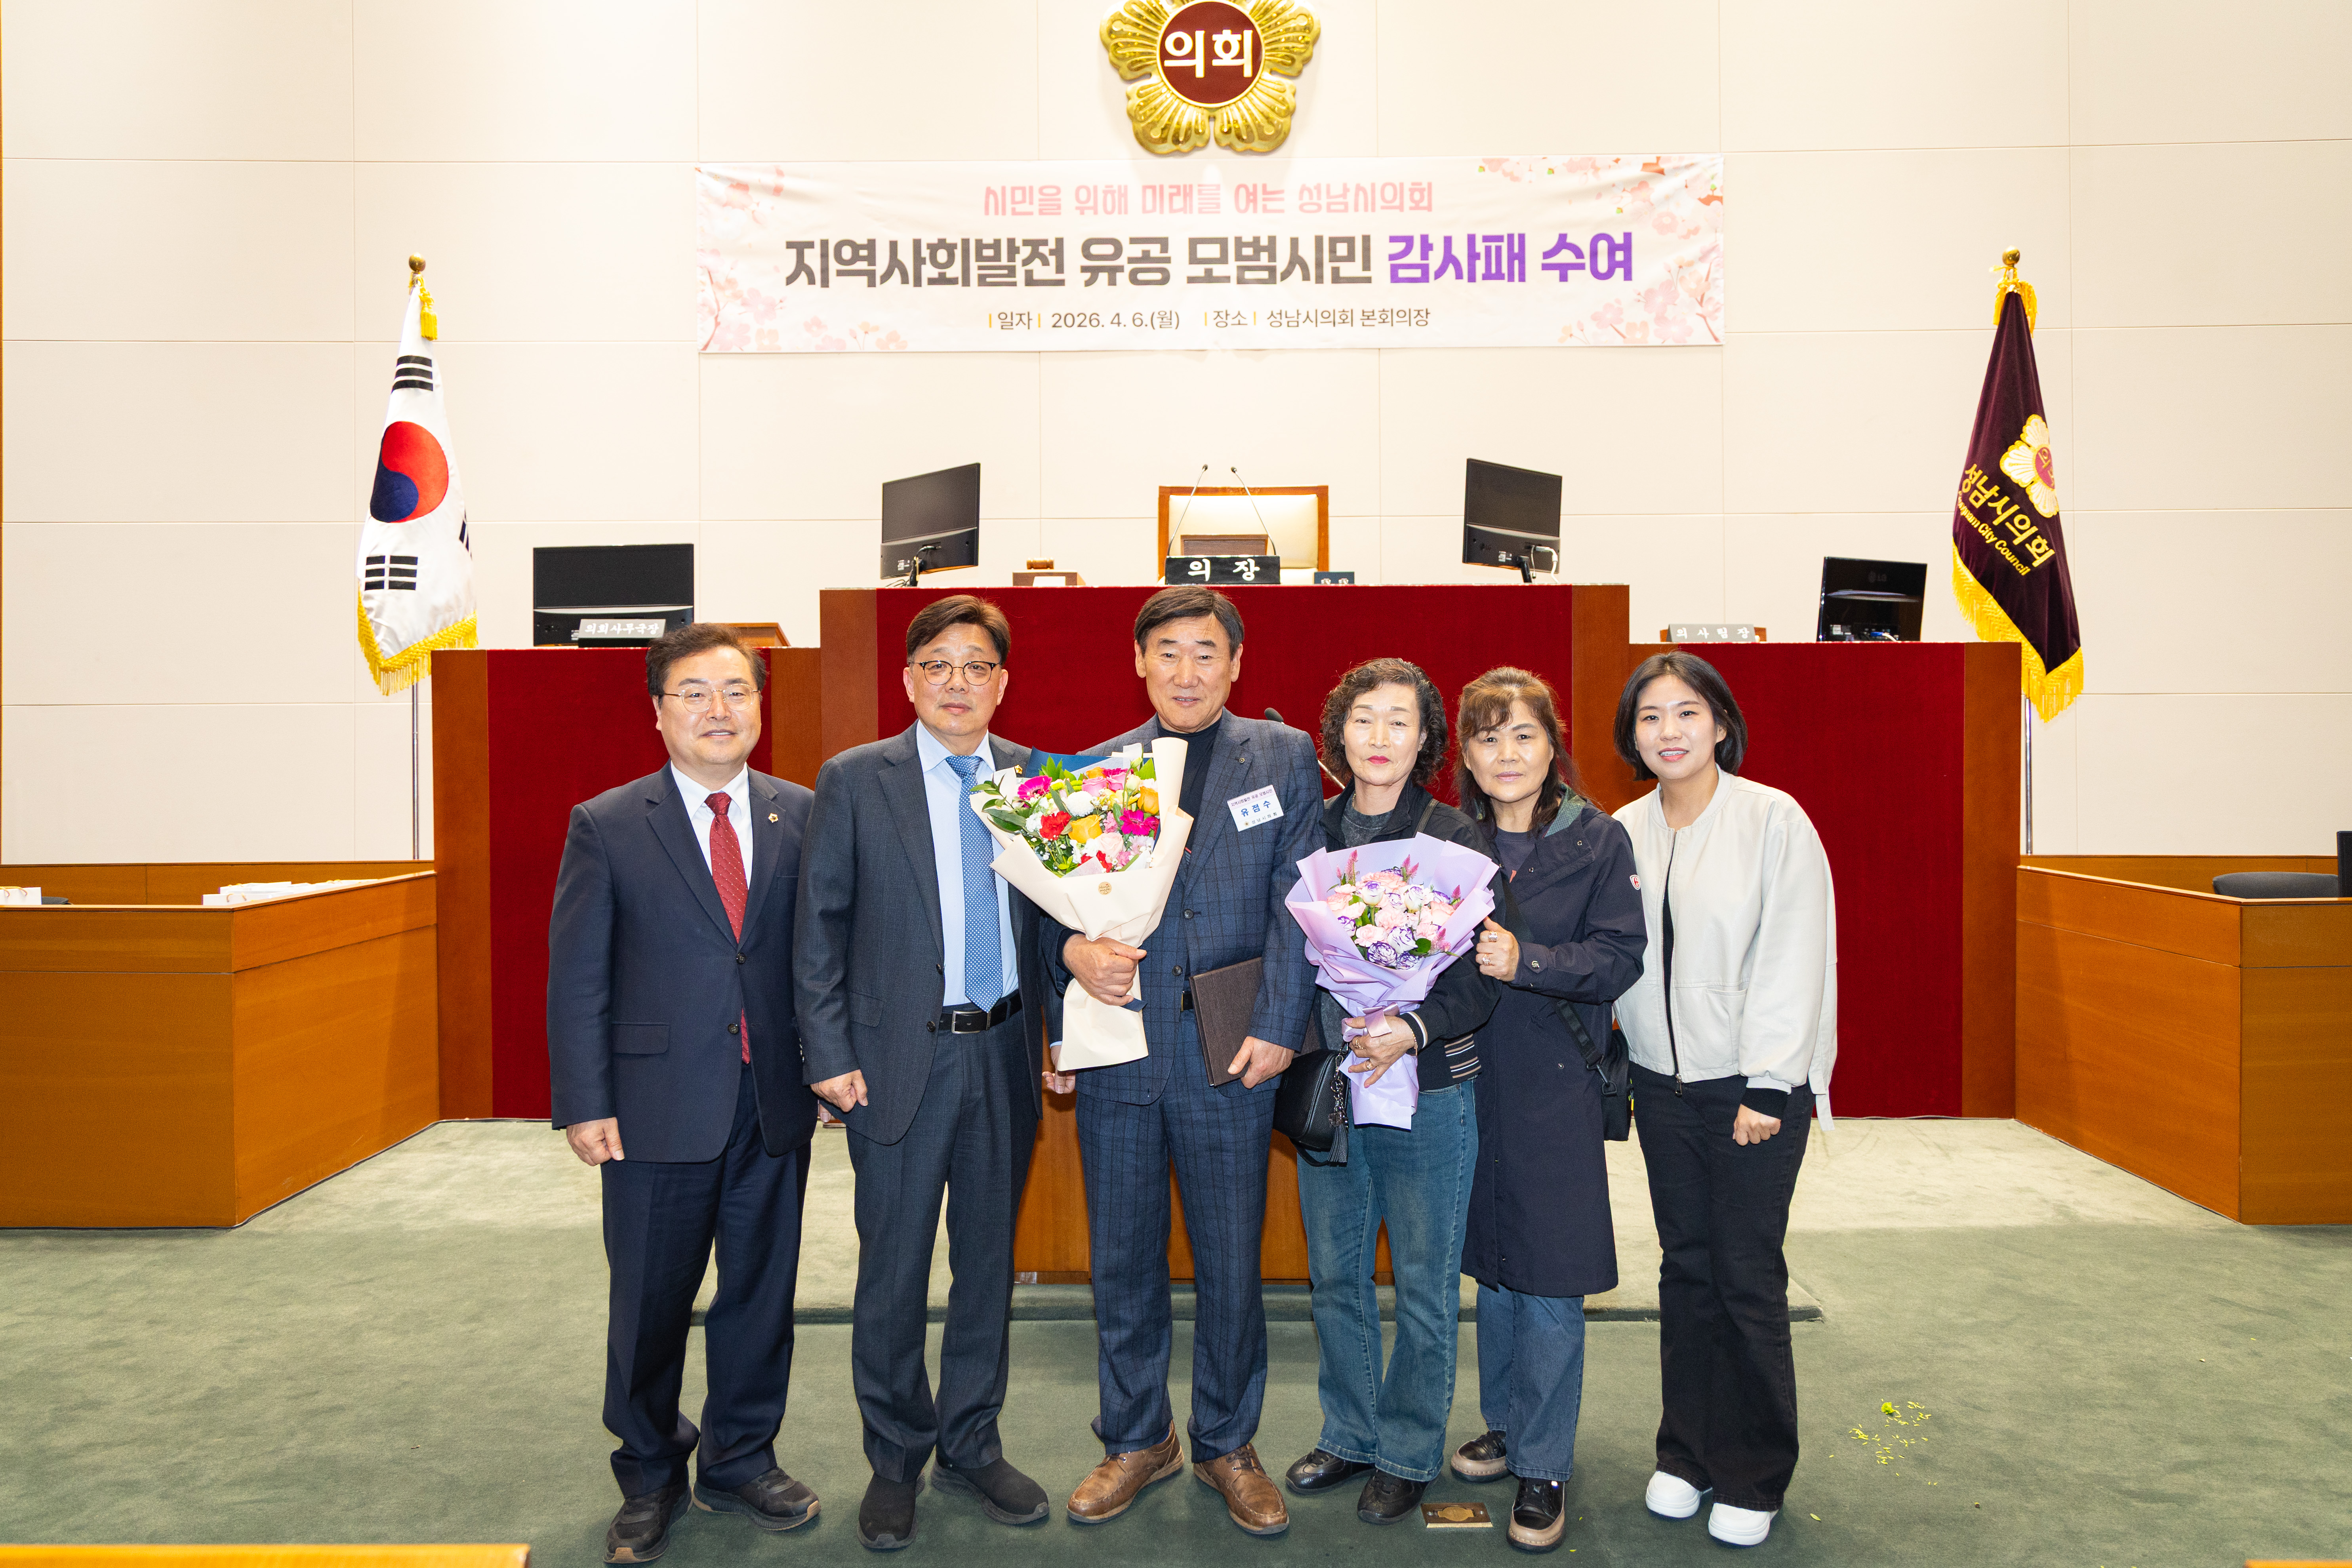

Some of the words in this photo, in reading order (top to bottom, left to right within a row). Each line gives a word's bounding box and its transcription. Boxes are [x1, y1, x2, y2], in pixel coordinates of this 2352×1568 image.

[1164, 29, 1253, 78] 의회
[984, 185, 1062, 216] 시민을
[1075, 185, 1128, 215] 위해
[1142, 184, 1221, 215] 미래를
[1234, 183, 1285, 213] 여는
[1299, 182, 1433, 213] 성남시의회
[786, 238, 1065, 288] 지역사회발전
[1080, 237, 1172, 288] 유공
[1187, 235, 1372, 285] 모범시민
[1388, 234, 1526, 284] 감사패
[1541, 232, 1633, 282] 수여
[998, 312, 1033, 330] 일자
[1052, 313, 1105, 328] 2026.
[1110, 313, 1127, 328] 4.
[1132, 311, 1180, 330] 6.(월)
[1213, 310, 1248, 329] 장소
[1267, 309, 1354, 328] 성남시의회
[1360, 309, 1431, 328] 본회의장
[1961, 463, 2055, 568] 성남시의회
[1978, 523, 1998, 543] City
[1995, 540, 2031, 576] Council
[1187, 558, 1260, 581] 의장
[584, 623, 660, 635] 의회사무국장
[1231, 796, 1251, 807] 지역사회발전
